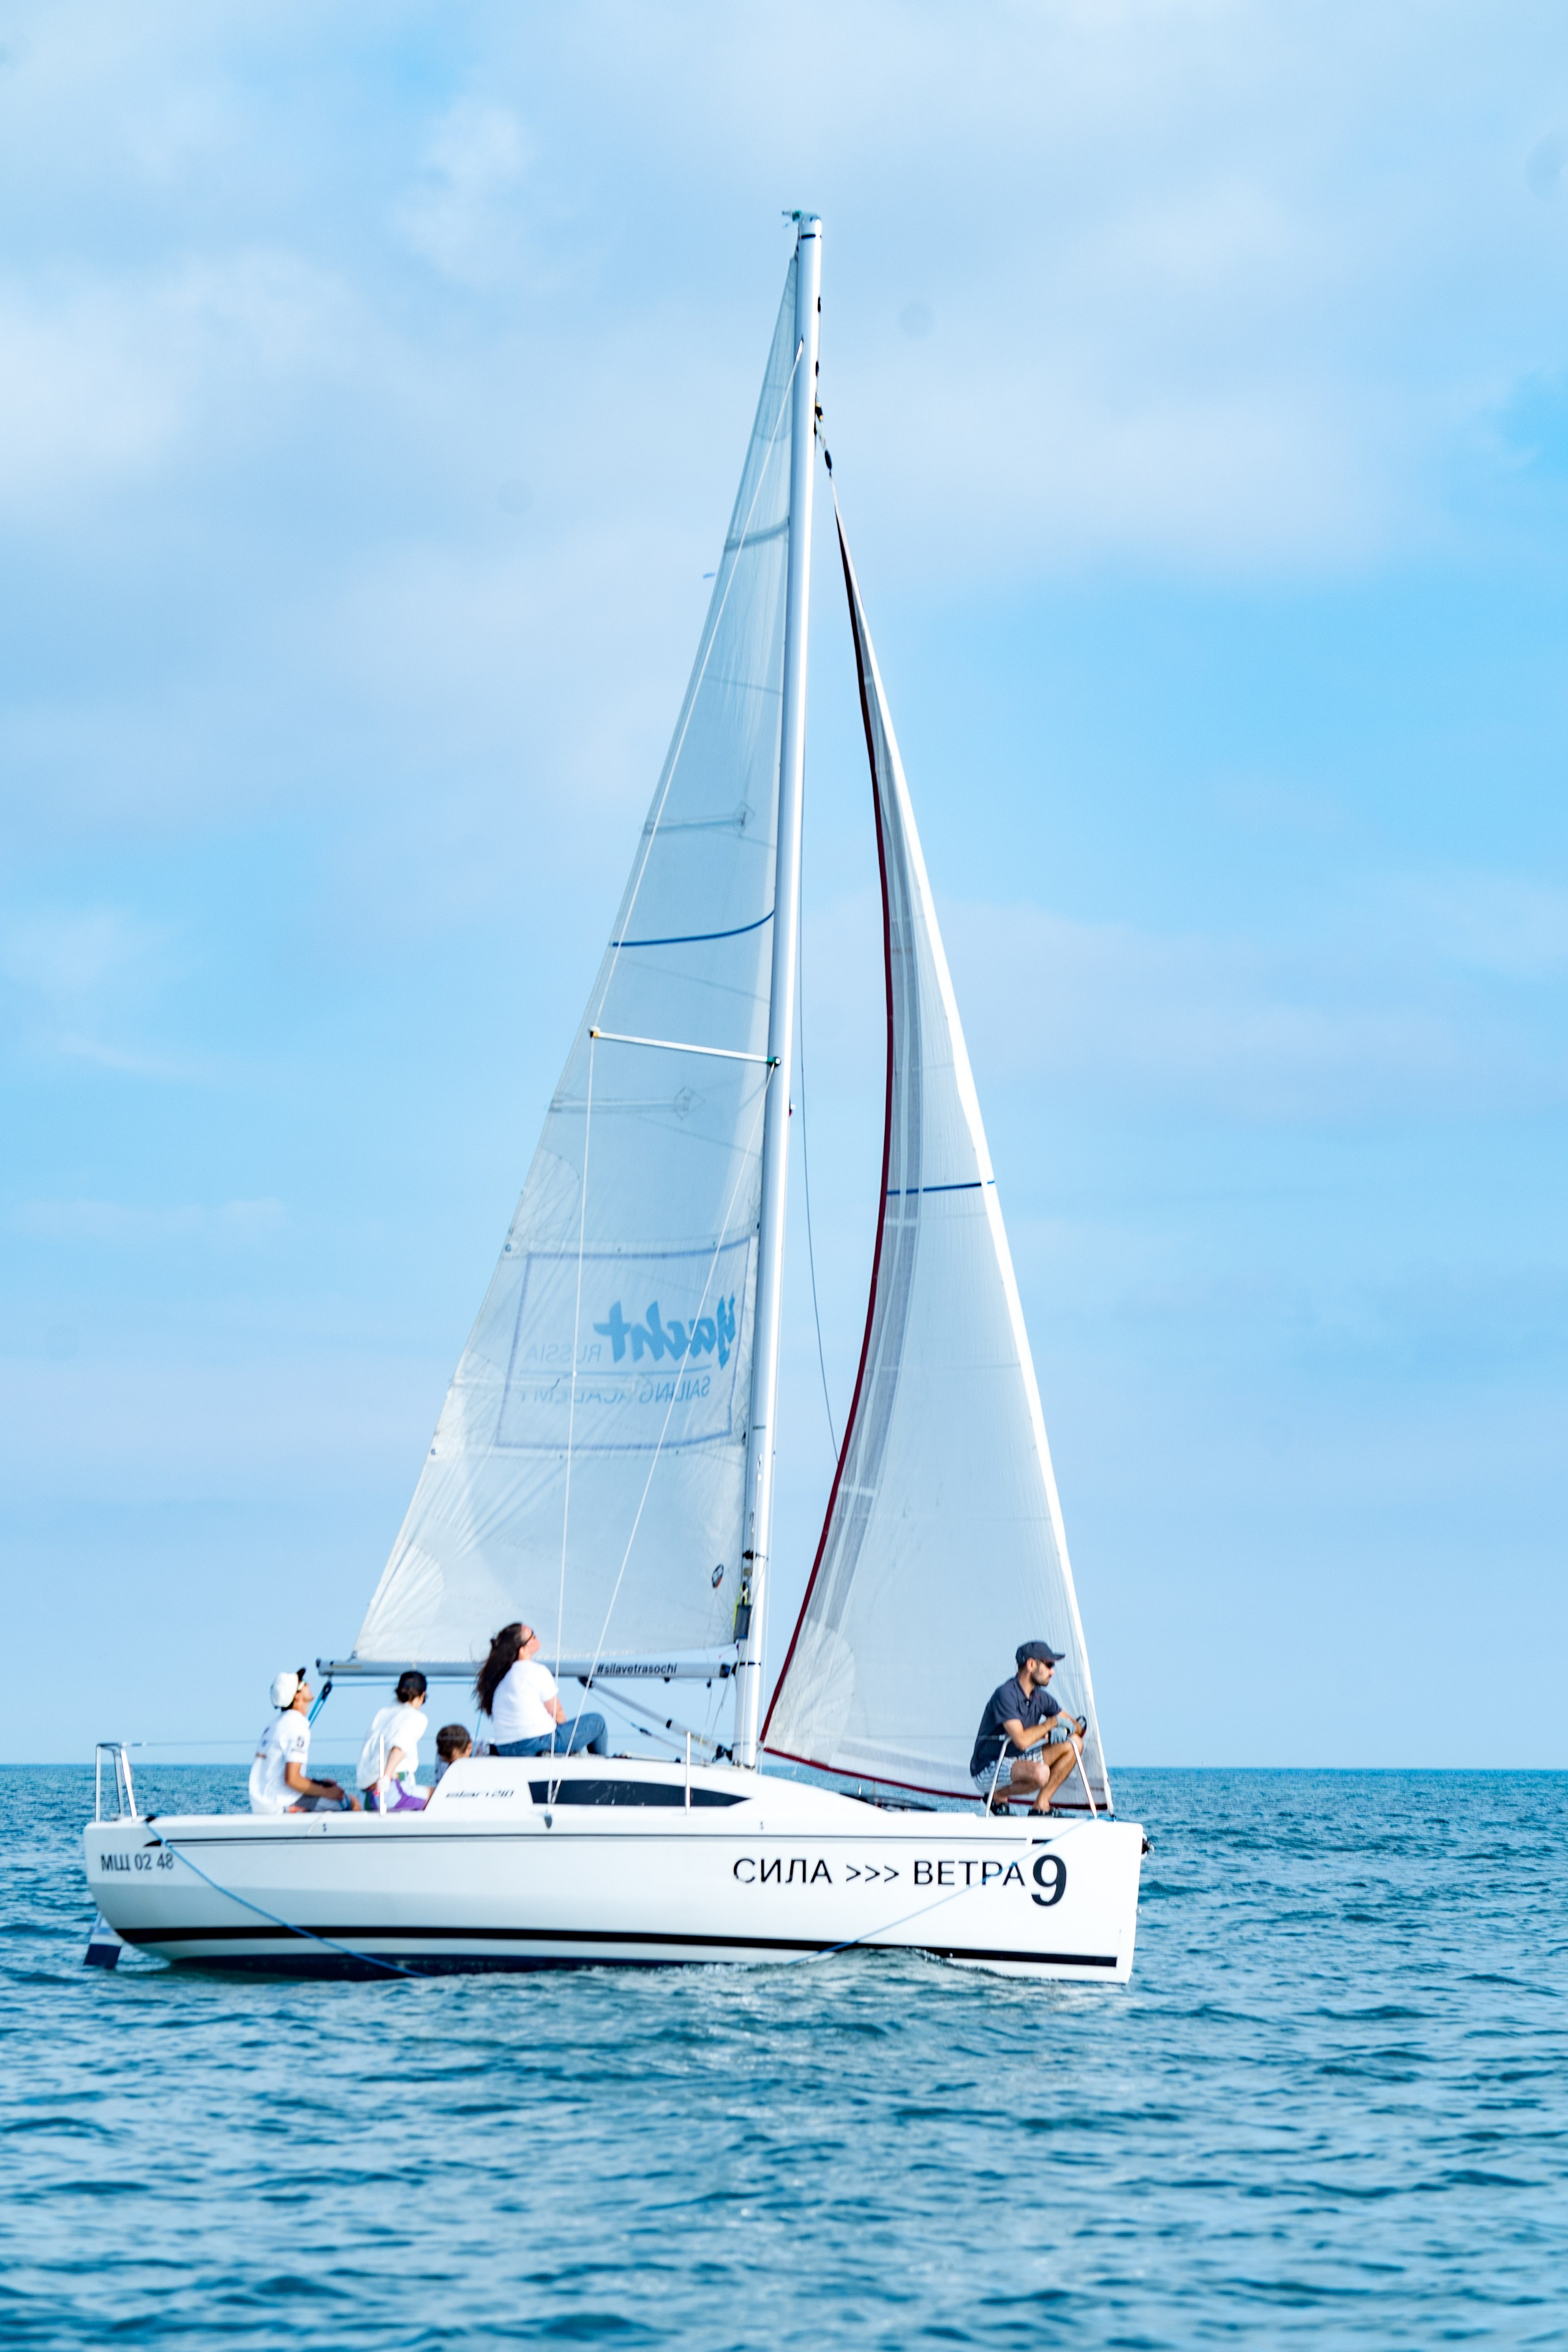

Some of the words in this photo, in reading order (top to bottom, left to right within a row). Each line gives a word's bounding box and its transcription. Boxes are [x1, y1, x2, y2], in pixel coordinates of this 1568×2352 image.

[597, 1663, 677, 1675] #silavetrasochi
[134, 1854, 152, 1870] 02
[157, 1853, 174, 1869] 48
[733, 1858, 833, 1883] СИЛА
[914, 1861, 1026, 1886] ВЕТРА
[1031, 1854, 1068, 1906] 9
